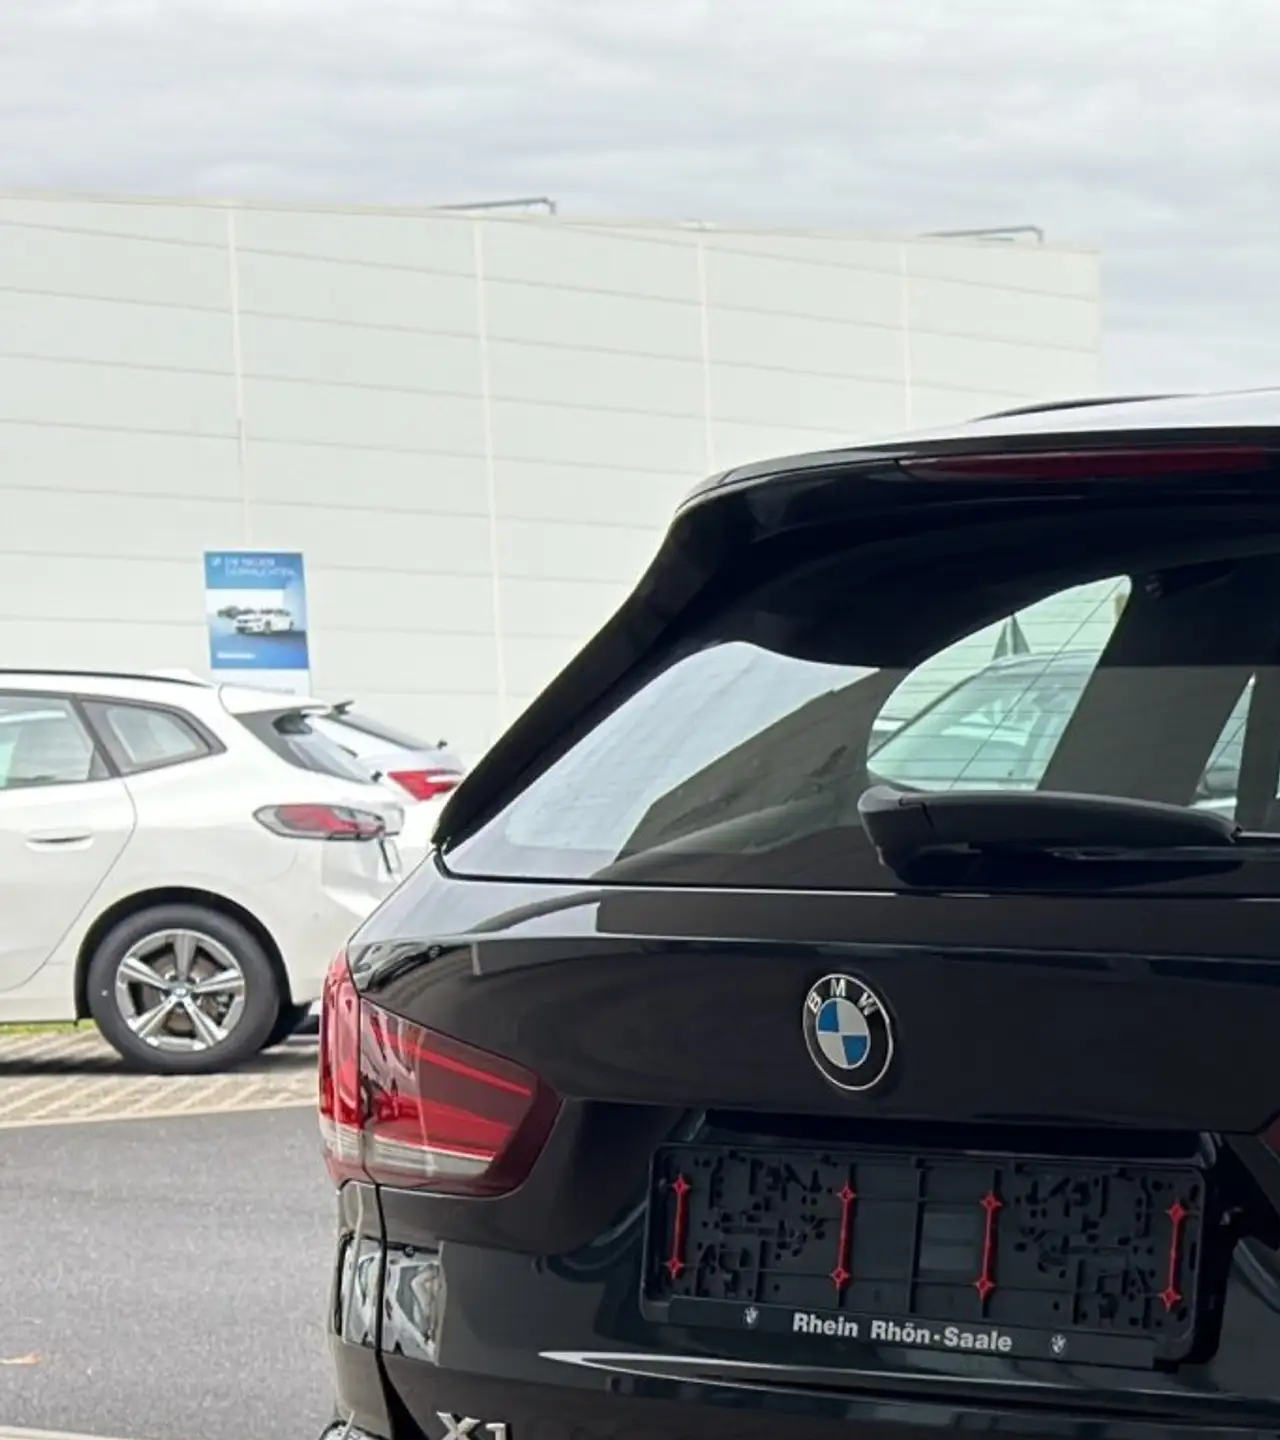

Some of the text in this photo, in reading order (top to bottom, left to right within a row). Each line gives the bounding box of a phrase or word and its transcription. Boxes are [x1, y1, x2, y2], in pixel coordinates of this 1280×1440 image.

[807, 979, 880, 1016] BMW
[793, 1313, 1013, 1351] Rhein Rhön-Saale
